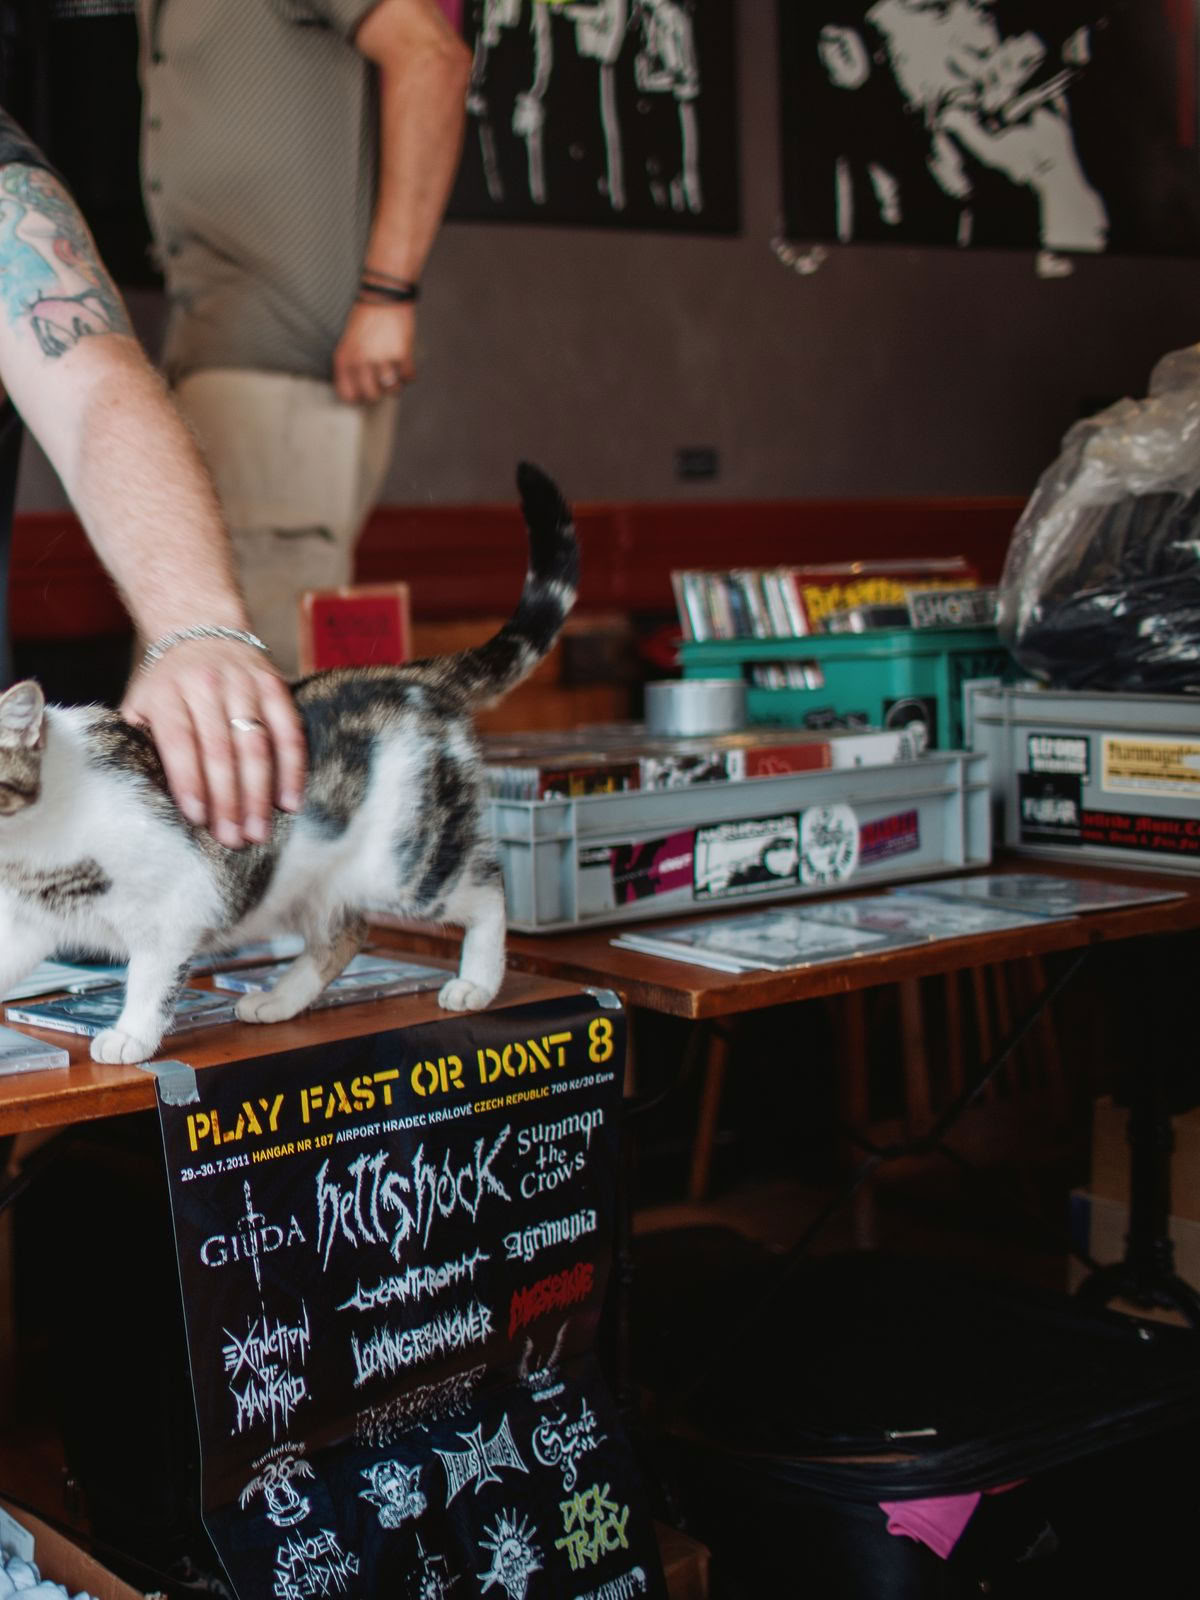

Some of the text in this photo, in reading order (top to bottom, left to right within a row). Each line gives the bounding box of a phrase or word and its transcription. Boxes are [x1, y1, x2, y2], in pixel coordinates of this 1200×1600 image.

[186, 1017, 614, 1152] PLAY FAST OR DONT 8
[225, 1153, 251, 1171] 2011
[252, 1142, 295, 1164] HANGAR
[296, 1138, 313, 1153] NR
[314, 1133, 334, 1149] 187
[335, 1123, 381, 1144] AIRPORT
[382, 1114, 427, 1133] HRADEC
[427, 1103, 473, 1125] KRÁLOVÉ
[473, 1095, 505, 1114] CZECH
[505, 1086, 550, 1106] REPUBLIC
[551, 1081, 568, 1095] 700
[595, 1071, 615, 1085] Euro
[516, 1107, 605, 1157] Summon
[519, 1150, 587, 1200] Crows
[536, 1143, 568, 1172] the
[502, 1208, 598, 1263] Agrimonia
[559, 1482, 620, 1534] DICK
[554, 1504, 630, 1571] TRACY
